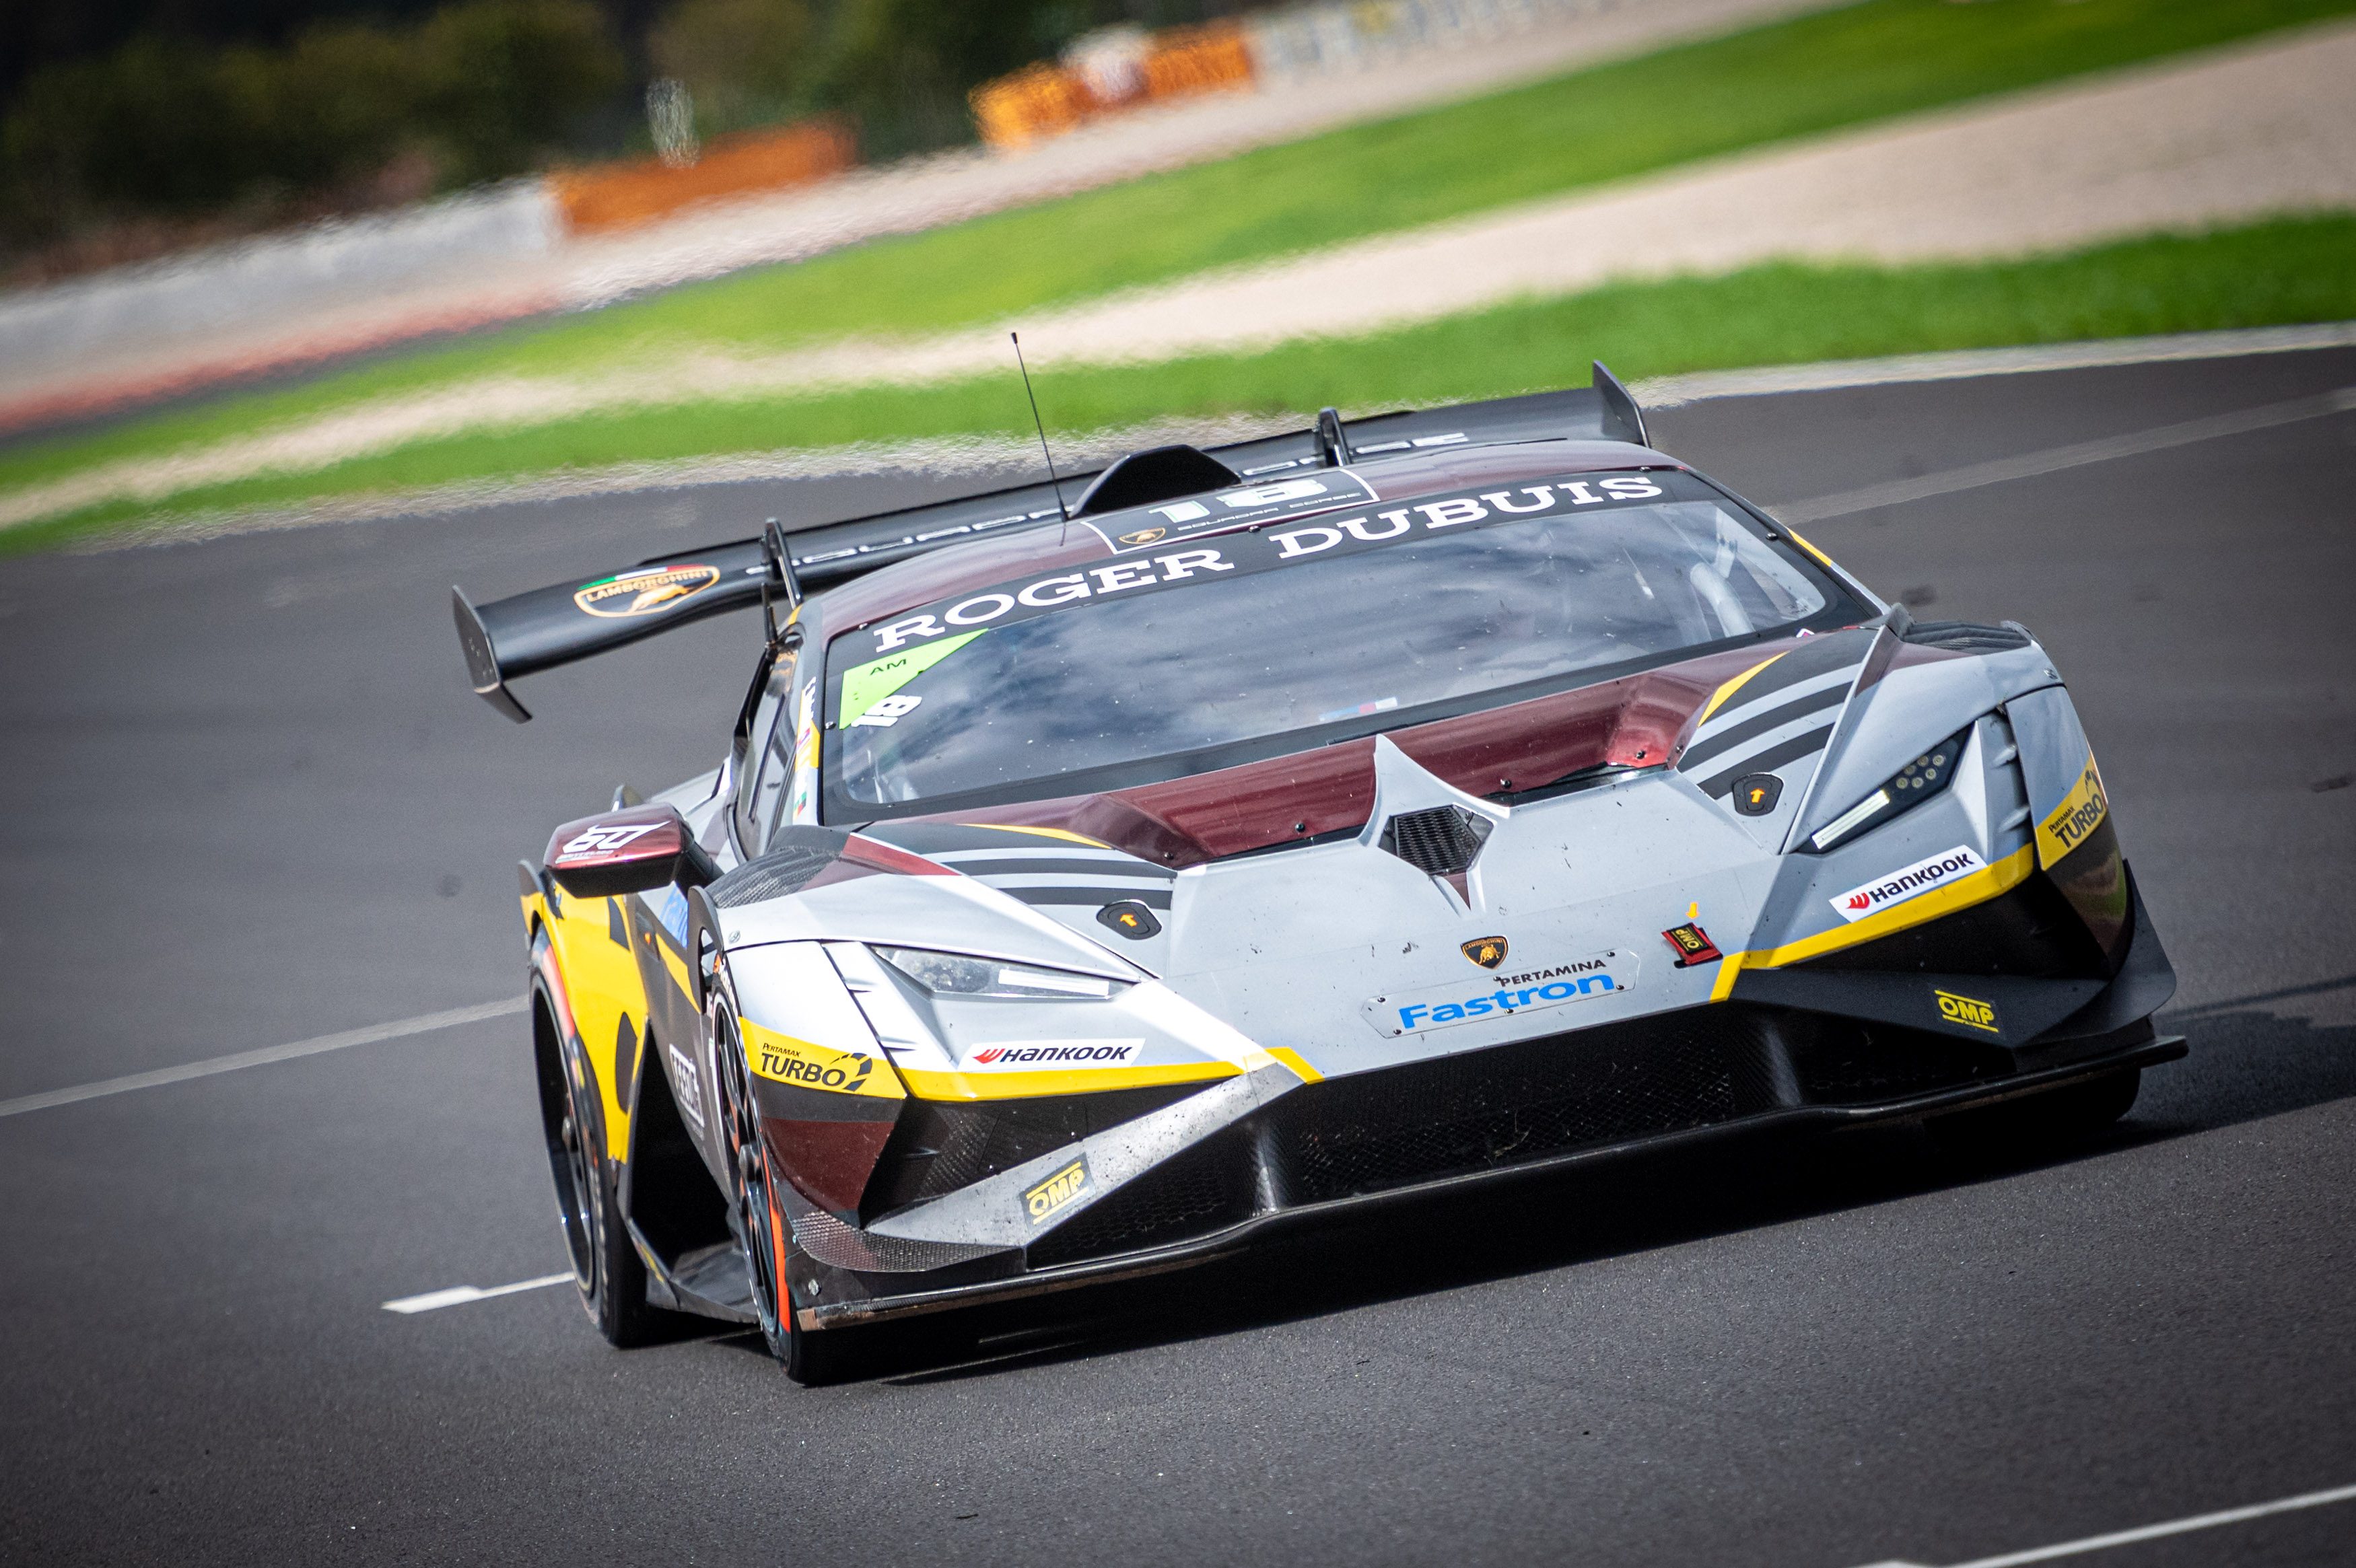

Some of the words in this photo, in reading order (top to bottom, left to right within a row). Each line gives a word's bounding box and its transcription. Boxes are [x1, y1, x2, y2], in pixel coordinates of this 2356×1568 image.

[873, 549, 1235, 653] ROGER
[1268, 476, 1663, 559] DUBUIS
[586, 571, 708, 602] LAMBORGHINI
[870, 658, 907, 676] AM
[851, 695, 922, 727] 18
[2054, 793, 2104, 849] TURBO
[1675, 929, 1699, 949] OMP
[1500, 959, 1606, 987] PERTAMINA
[1398, 973, 1615, 1030] Fastron
[1938, 997, 1995, 1026] OMP
[763, 1042, 801, 1057] PERTAMAX
[761, 1053, 846, 1087] TURBO
[1029, 1168, 1086, 1216] OMP
